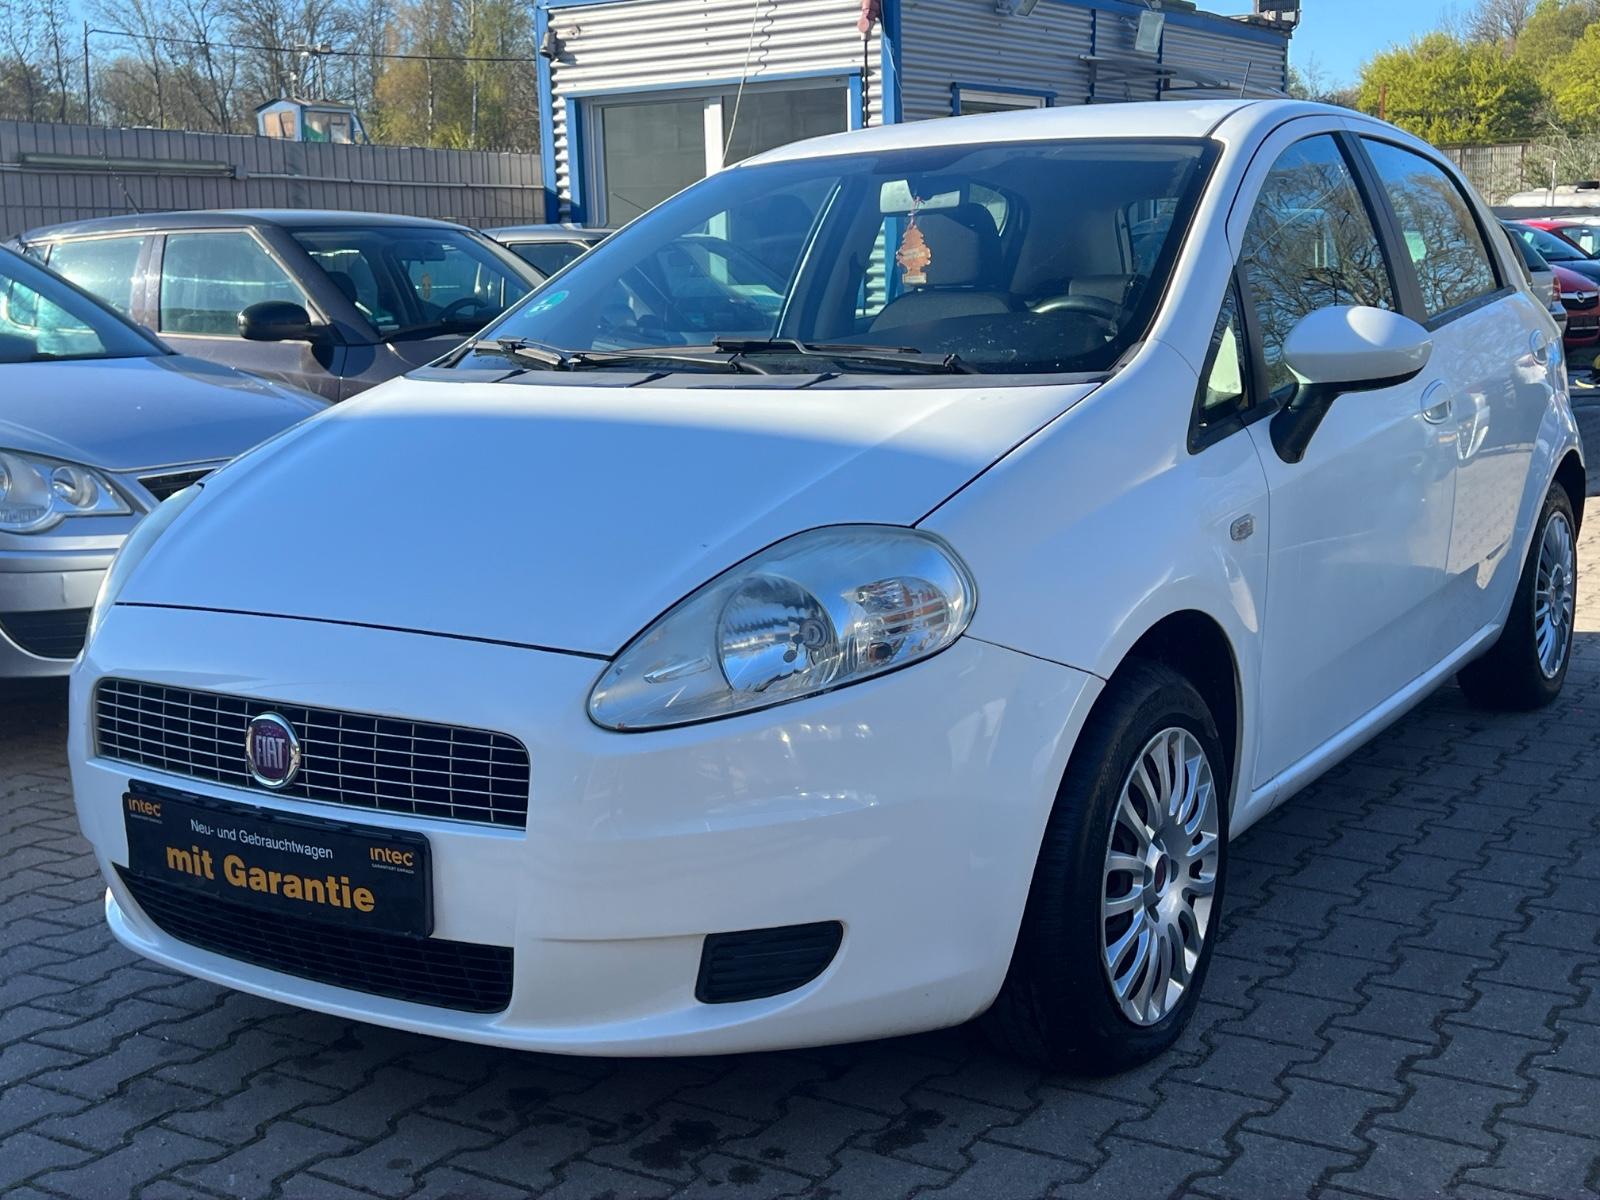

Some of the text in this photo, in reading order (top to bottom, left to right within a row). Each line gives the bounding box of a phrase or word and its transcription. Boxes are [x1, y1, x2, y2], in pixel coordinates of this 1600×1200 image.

[255, 735, 285, 769] FIAT
[190, 818, 333, 860] Neu- und Gebrauchtwagen
[166, 845, 375, 913] mit Garantie
